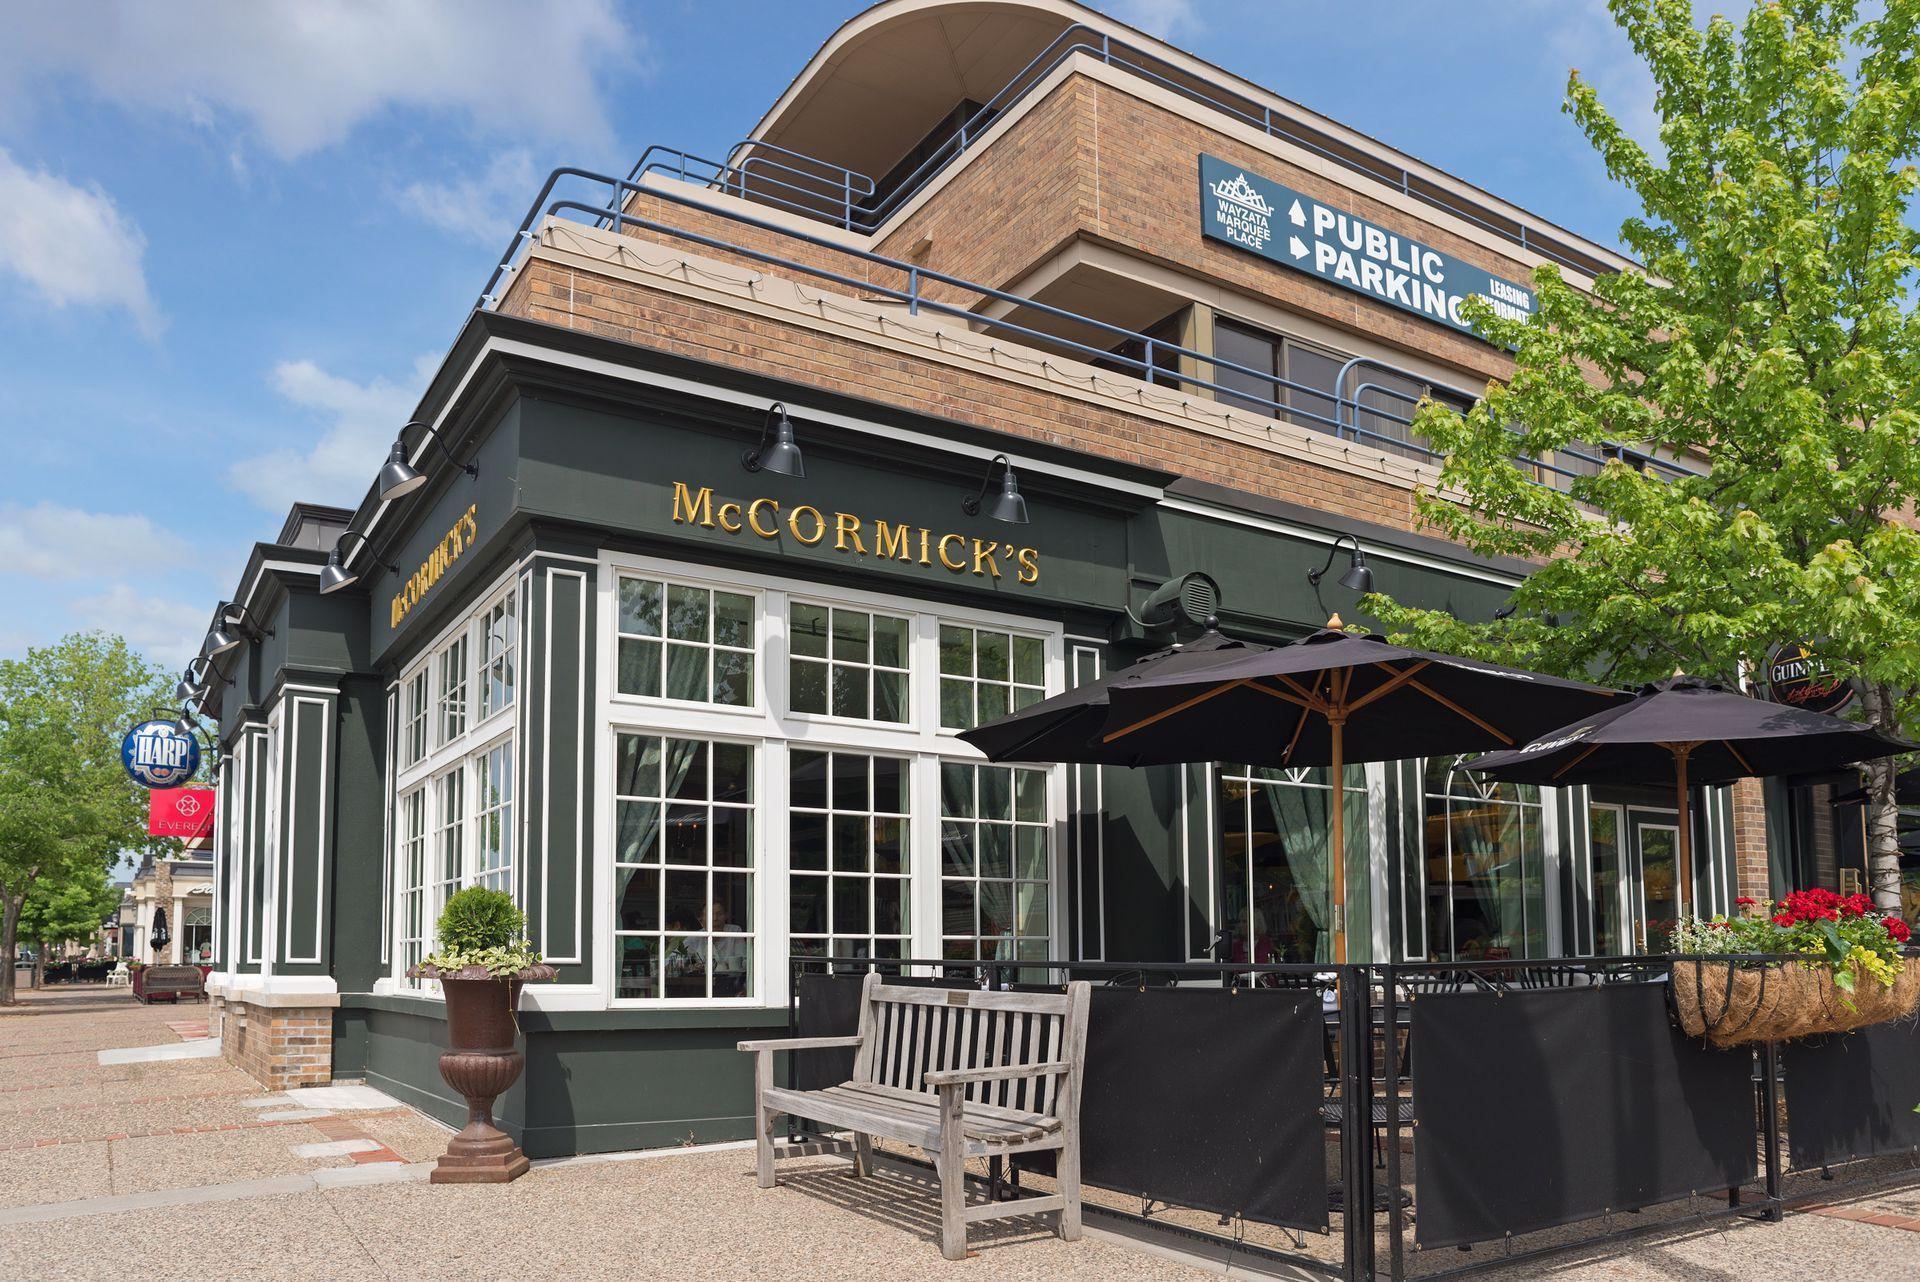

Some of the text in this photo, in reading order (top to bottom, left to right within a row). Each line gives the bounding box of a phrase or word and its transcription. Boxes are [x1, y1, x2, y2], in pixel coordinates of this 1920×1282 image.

[1216, 210, 1271, 241] MARQUEE
[1218, 199, 1268, 228] WAYZATA
[1226, 227, 1263, 250] PLACE
[1313, 204, 1444, 284] PUBLIC
[1489, 279, 1529, 309] LEASING
[137, 736, 187, 767] HARP
[158, 819, 211, 831] EVERE
